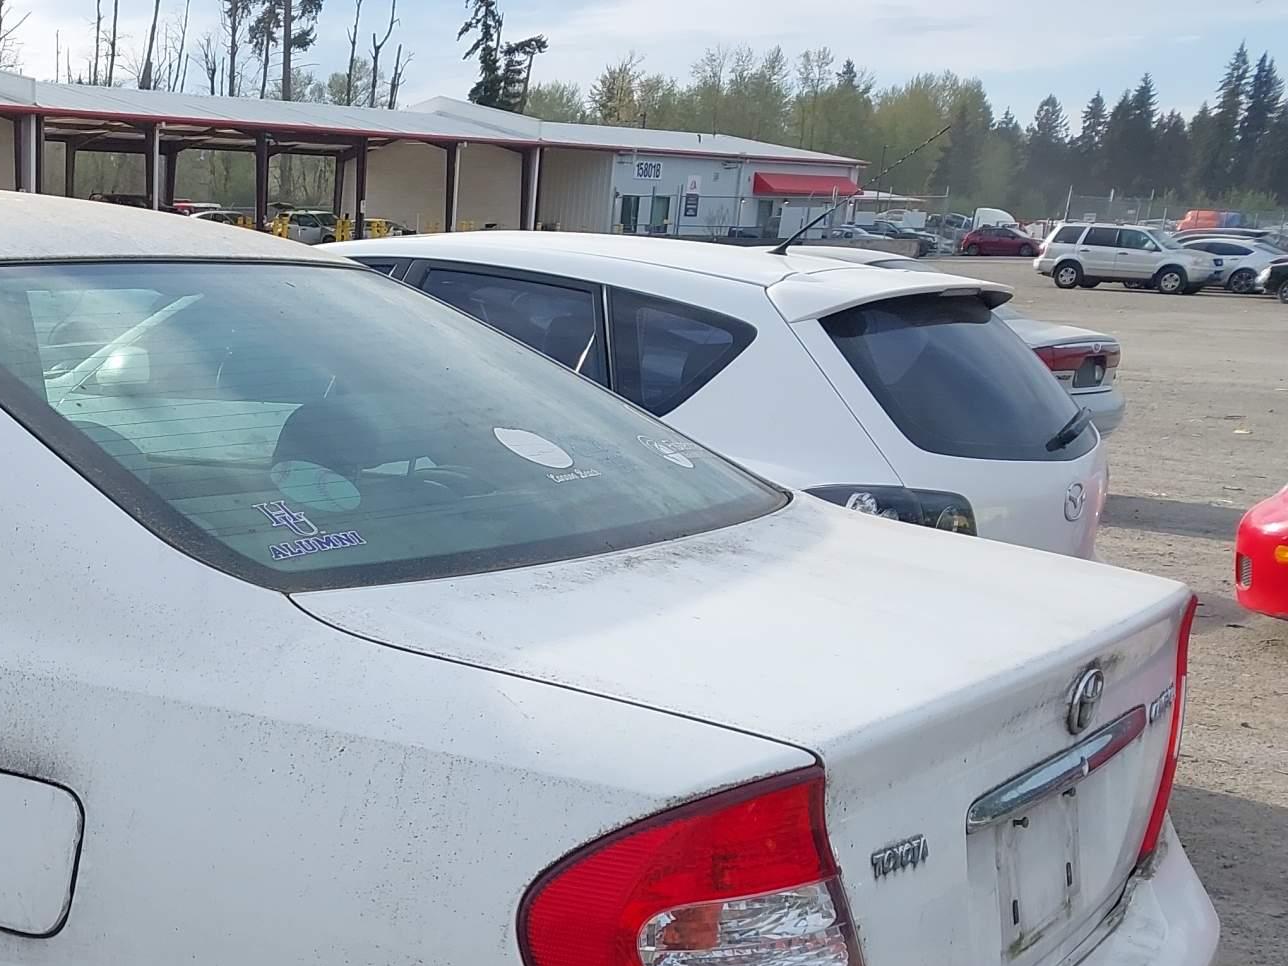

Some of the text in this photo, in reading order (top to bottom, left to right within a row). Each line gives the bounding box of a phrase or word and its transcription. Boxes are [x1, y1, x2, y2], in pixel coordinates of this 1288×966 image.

[252, 500, 318, 535] HU
[269, 530, 367, 560] ALUMNI
[871, 836, 929, 879] TOYOTA
